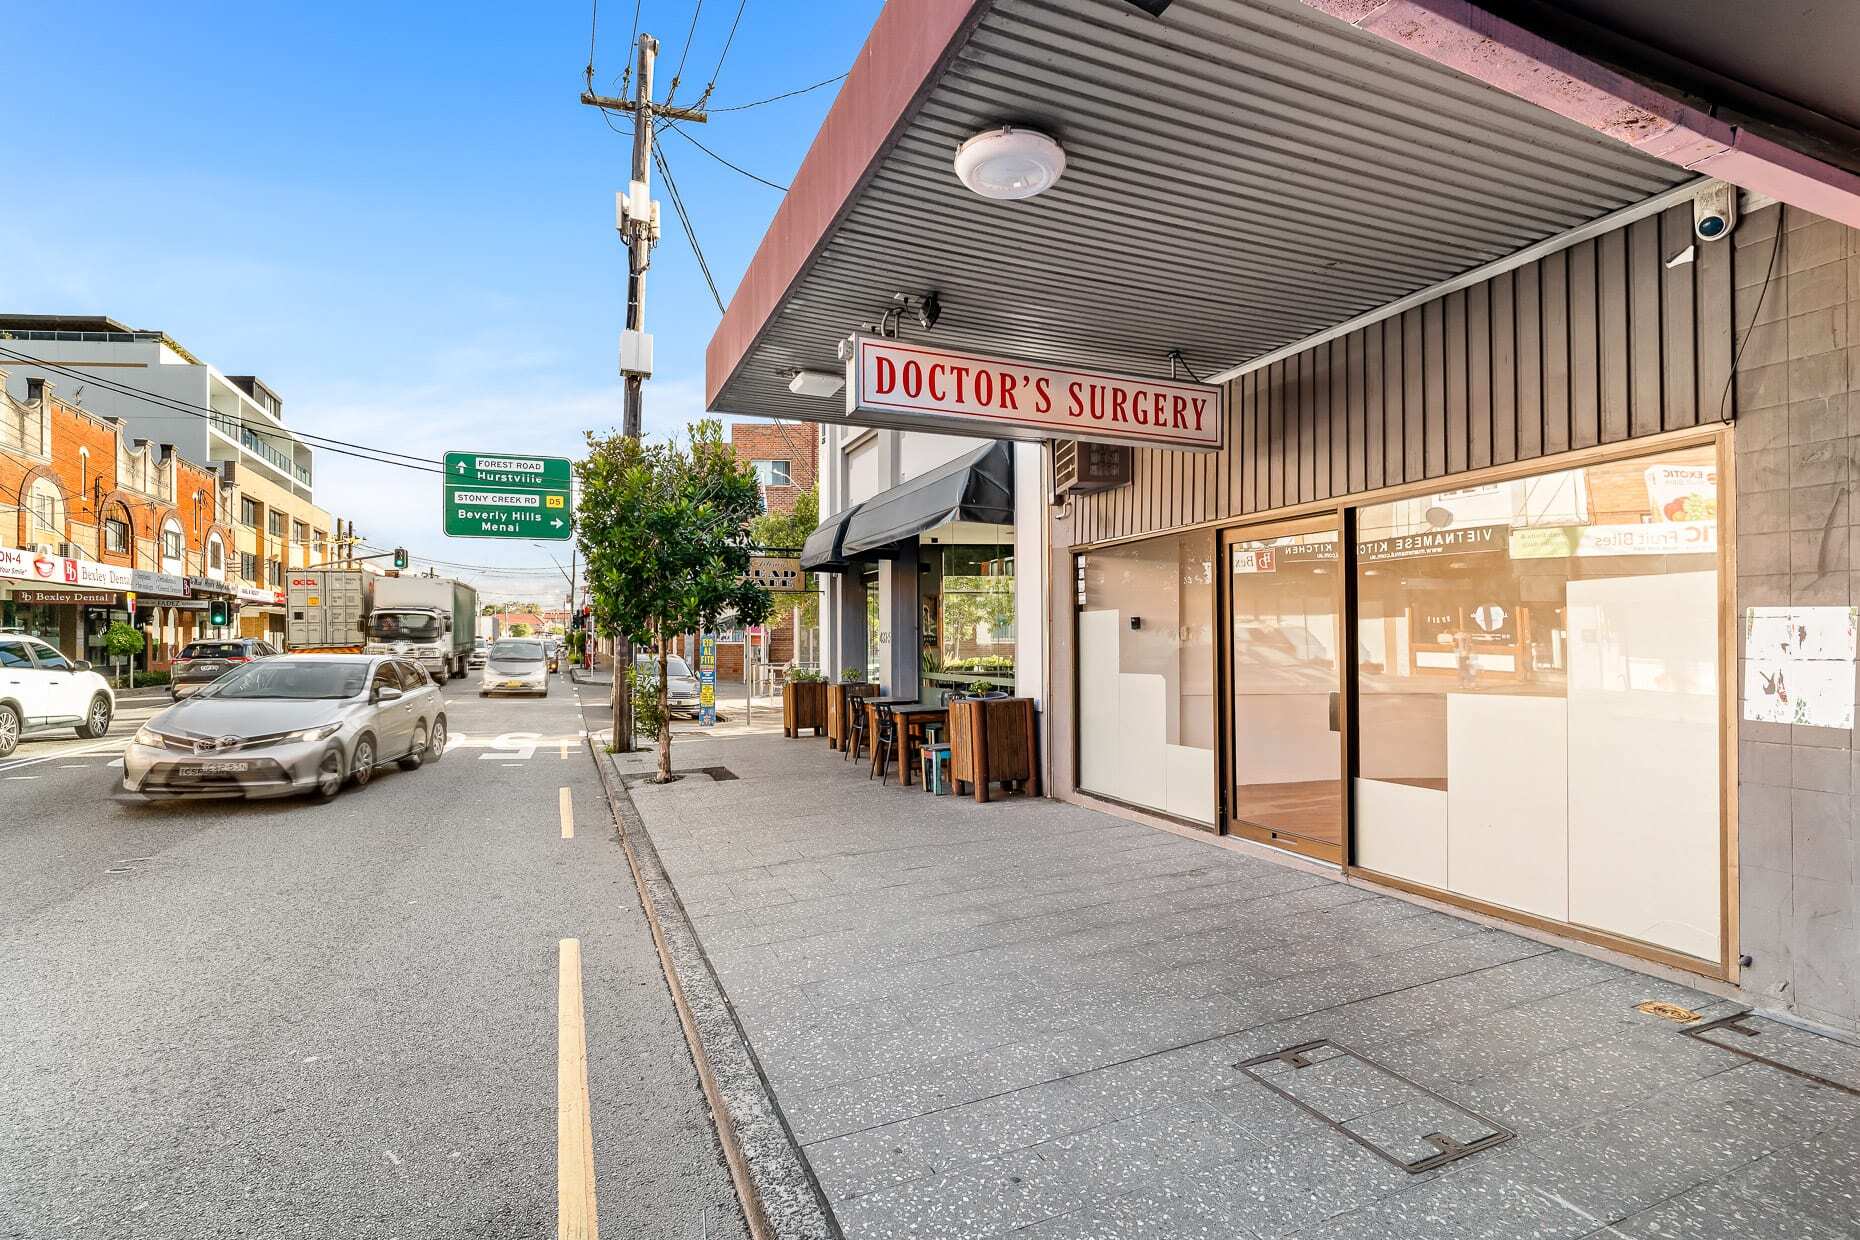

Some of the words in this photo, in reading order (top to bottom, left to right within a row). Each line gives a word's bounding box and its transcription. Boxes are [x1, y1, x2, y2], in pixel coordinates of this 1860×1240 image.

[875, 355, 1052, 414] DOCTOR'S
[1068, 381, 1207, 432] SURGERY
[478, 460, 513, 469] FOREST
[516, 461, 541, 470] ROAD
[477, 471, 543, 484] Hurstville
[457, 494, 488, 503] STONY
[491, 495, 522, 504] CREEK
[524, 497, 537, 505] RD
[549, 498, 561, 506] D5
[458, 509, 507, 521] Beverly
[512, 511, 542, 522] Hills
[481, 521, 519, 532] Menai
[81, 566, 107, 585] Bexley
[109, 570, 132, 585] Dental
[36, 592, 71, 603] Bexley
[74, 593, 108, 601] Dental
